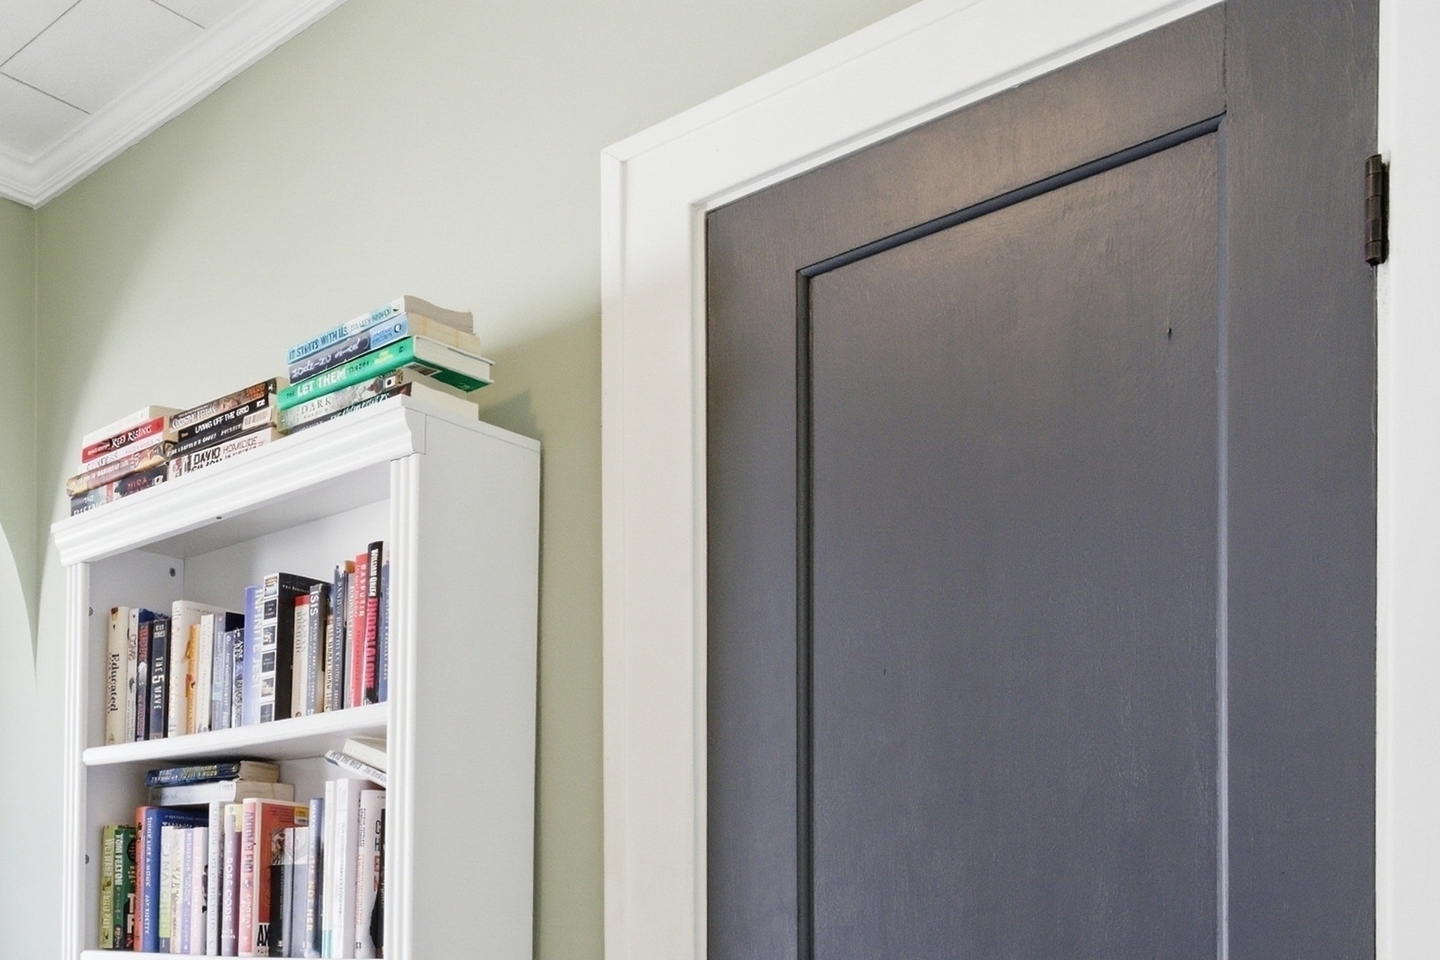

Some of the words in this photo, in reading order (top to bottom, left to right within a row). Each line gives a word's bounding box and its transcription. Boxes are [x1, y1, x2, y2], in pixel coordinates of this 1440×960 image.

[296, 340, 319, 358] STARTS
[320, 331, 339, 347] WITH
[338, 326, 349, 340] US
[297, 380, 315, 398] LET
[316, 367, 347, 390] THEM
[195, 420, 213, 434] LIVING
[213, 416, 224, 427] OFF
[224, 411, 236, 423] THE
[236, 405, 250, 417] GRID
[301, 397, 331, 416] DARK
[111, 434, 127, 449] RED
[127, 425, 152, 442] RISING
[193, 447, 221, 466] DAVID
[310, 590, 320, 616] ISIS
[155, 656, 163, 672] THE
[110, 653, 120, 713] Educated
[153, 685, 163, 709] WAVE
[115, 833, 124, 854] TOM
[115, 855, 123, 886] FELTON
[143, 908, 151, 935] SHETTY
